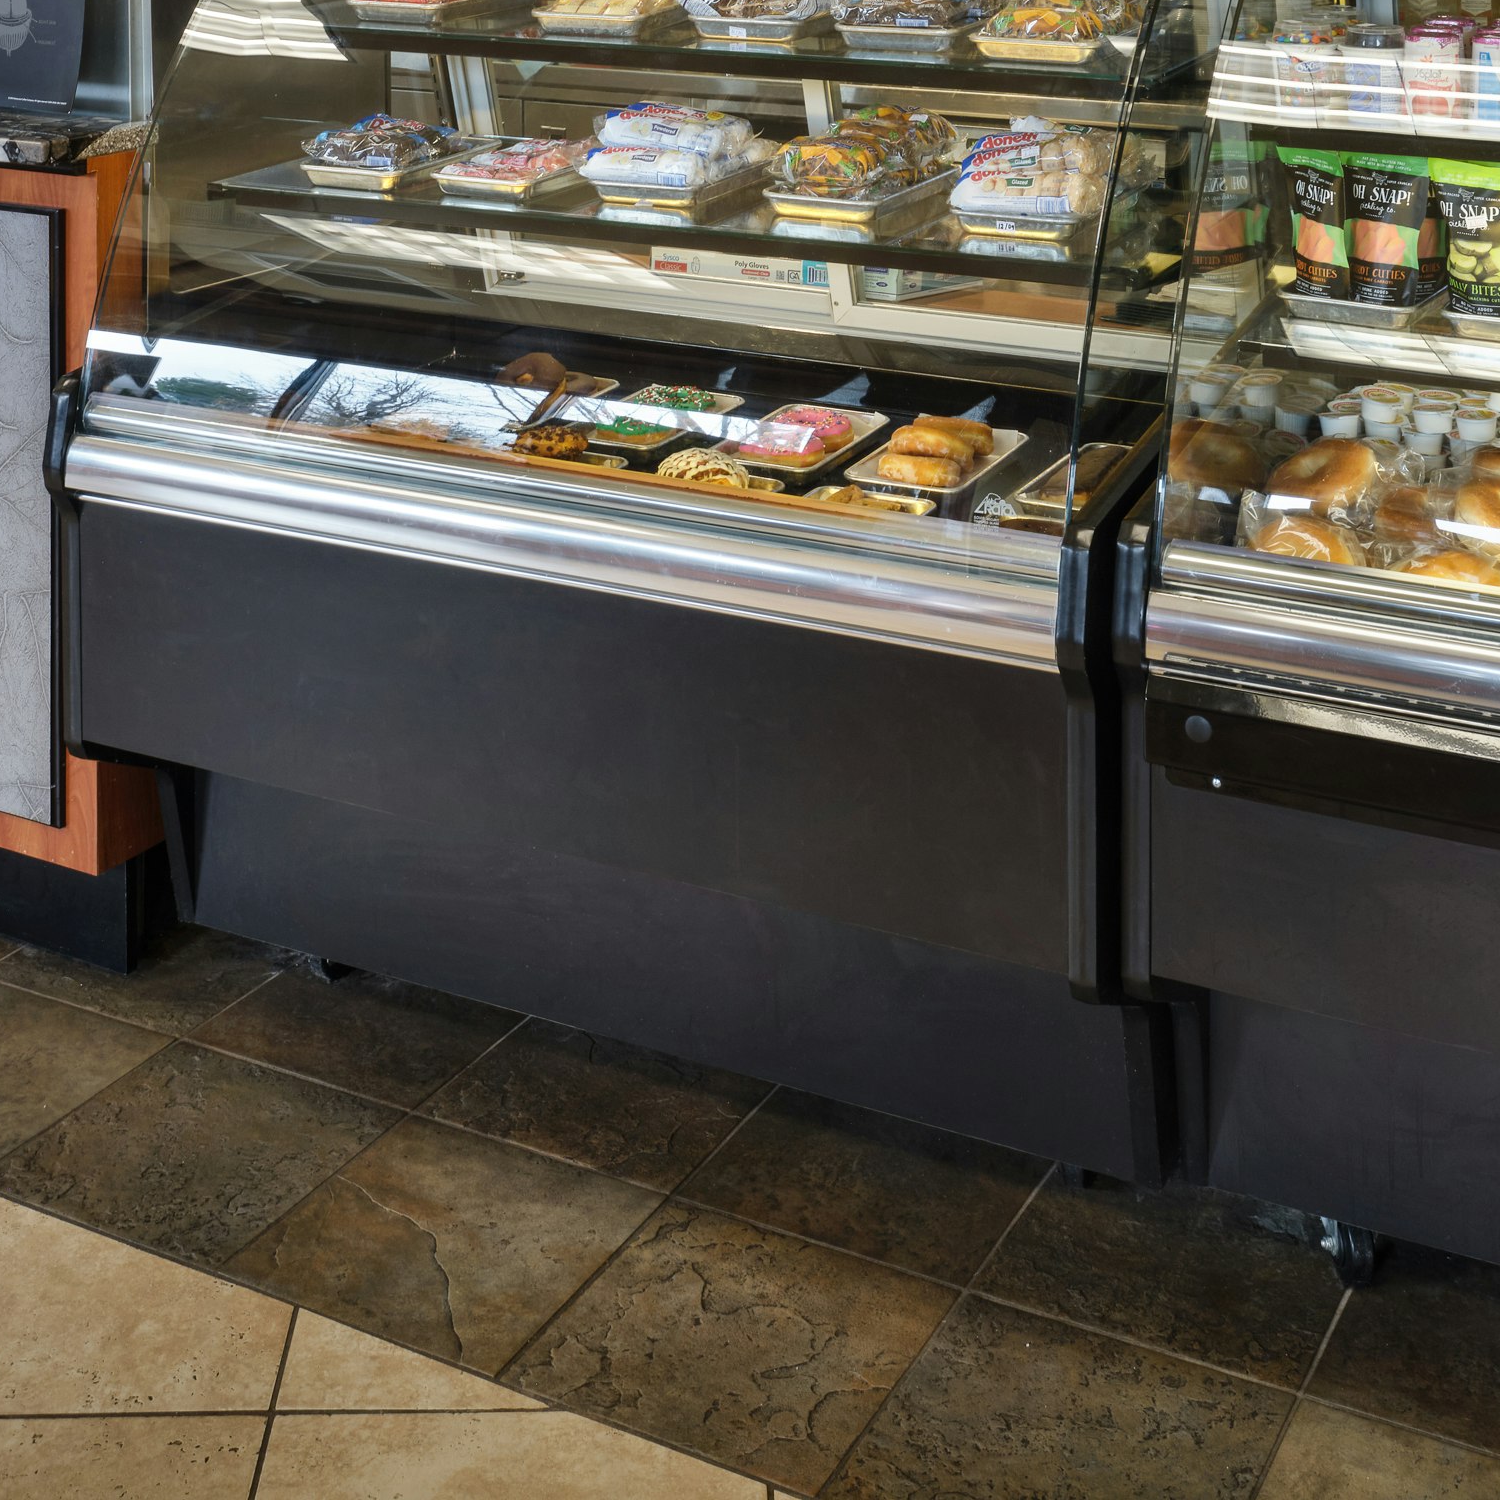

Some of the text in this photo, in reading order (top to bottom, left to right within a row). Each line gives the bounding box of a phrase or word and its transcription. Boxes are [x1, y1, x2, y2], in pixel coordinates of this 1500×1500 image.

[1353, 184, 1411, 206] OH SNAP!
[662, 253, 680, 261] Sysco
[659, 260, 769, 271] Classic Poly Gloves
[1372, 269, 1406, 279] CUTIES
